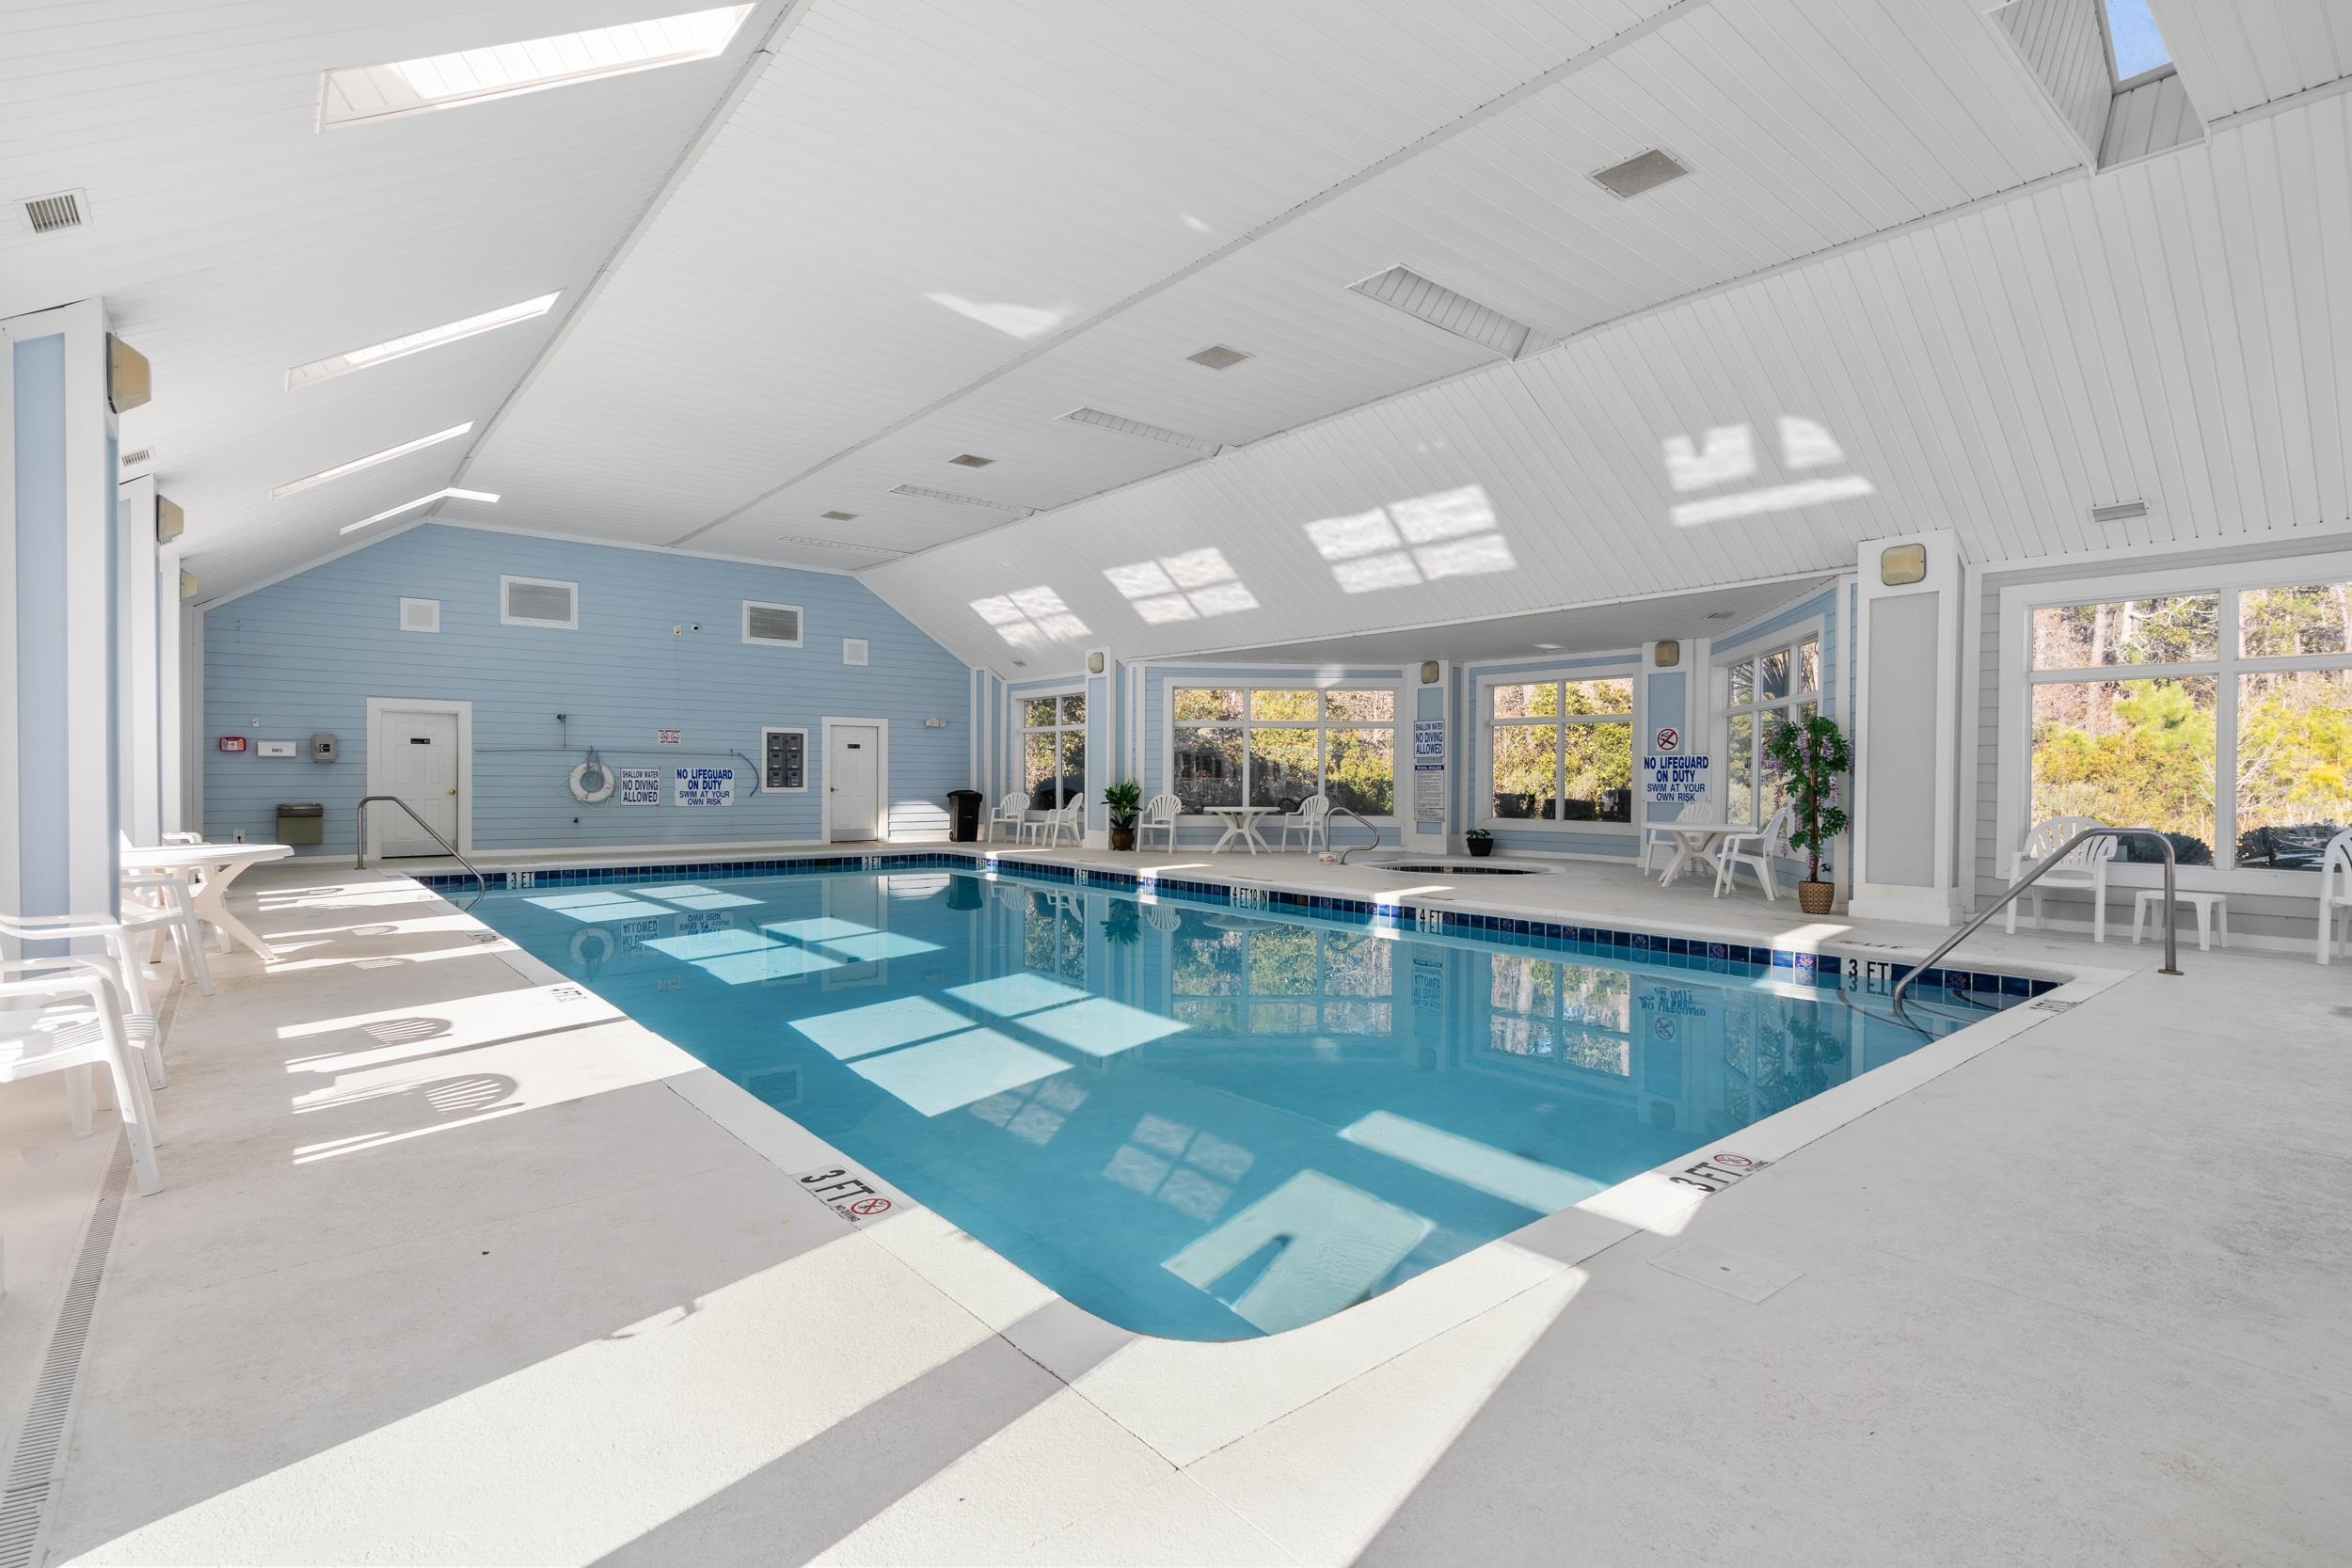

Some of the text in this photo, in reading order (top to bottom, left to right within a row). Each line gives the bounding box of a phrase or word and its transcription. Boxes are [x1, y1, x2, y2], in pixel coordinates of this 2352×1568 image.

[1415, 732, 1442, 743] NO DIVING
[1416, 743, 1442, 754] ALLOWED
[1644, 756, 1708, 769] NO LIFEGUARD
[676, 769, 733, 780] NO LIFEGUARD
[1656, 770, 1695, 783] ON DUTY
[622, 780, 659, 791] NO DIVING
[688, 780, 722, 790] ON DUTY
[1647, 784, 1705, 792] SWIM AT YOUR
[623, 792, 658, 802] ALLOWED
[1656, 793, 1695, 801] OWN RISK
[511, 871, 534, 881] 3 FT
[1232, 887, 1267, 900] 4 FT 10 IN
[1420, 909, 1441, 923] 4 FT
[1849, 958, 1889, 979] 3 FT
[1669, 1162, 1742, 1193] 3 FT
[801, 1169, 876, 1202] 3 FT
[840, 1210, 860, 1223] DIVING
